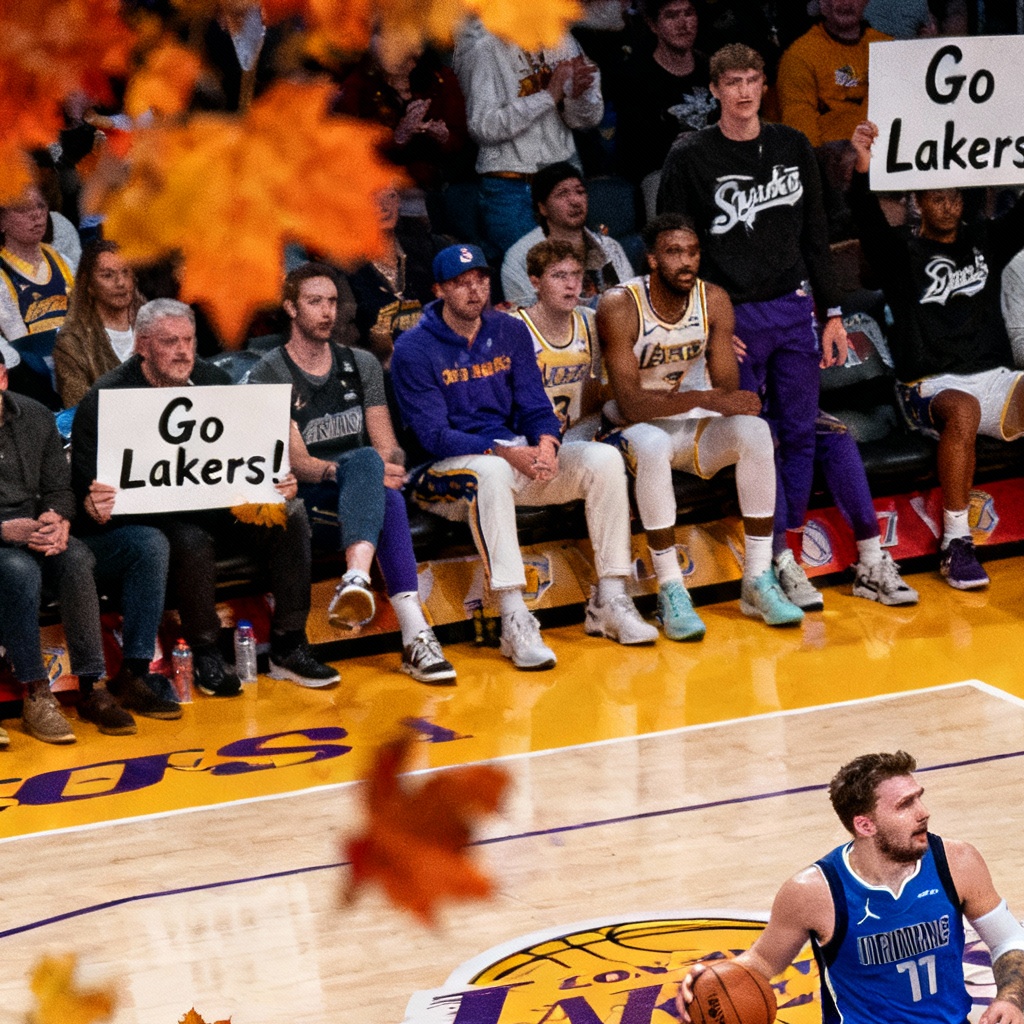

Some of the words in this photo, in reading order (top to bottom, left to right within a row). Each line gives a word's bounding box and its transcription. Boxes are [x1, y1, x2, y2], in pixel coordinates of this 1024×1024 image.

[925, 44, 995, 104] Go
[158, 396, 224, 445] Go
[119, 439, 285, 489] Lakers!
[896, 954, 938, 1003] 77
